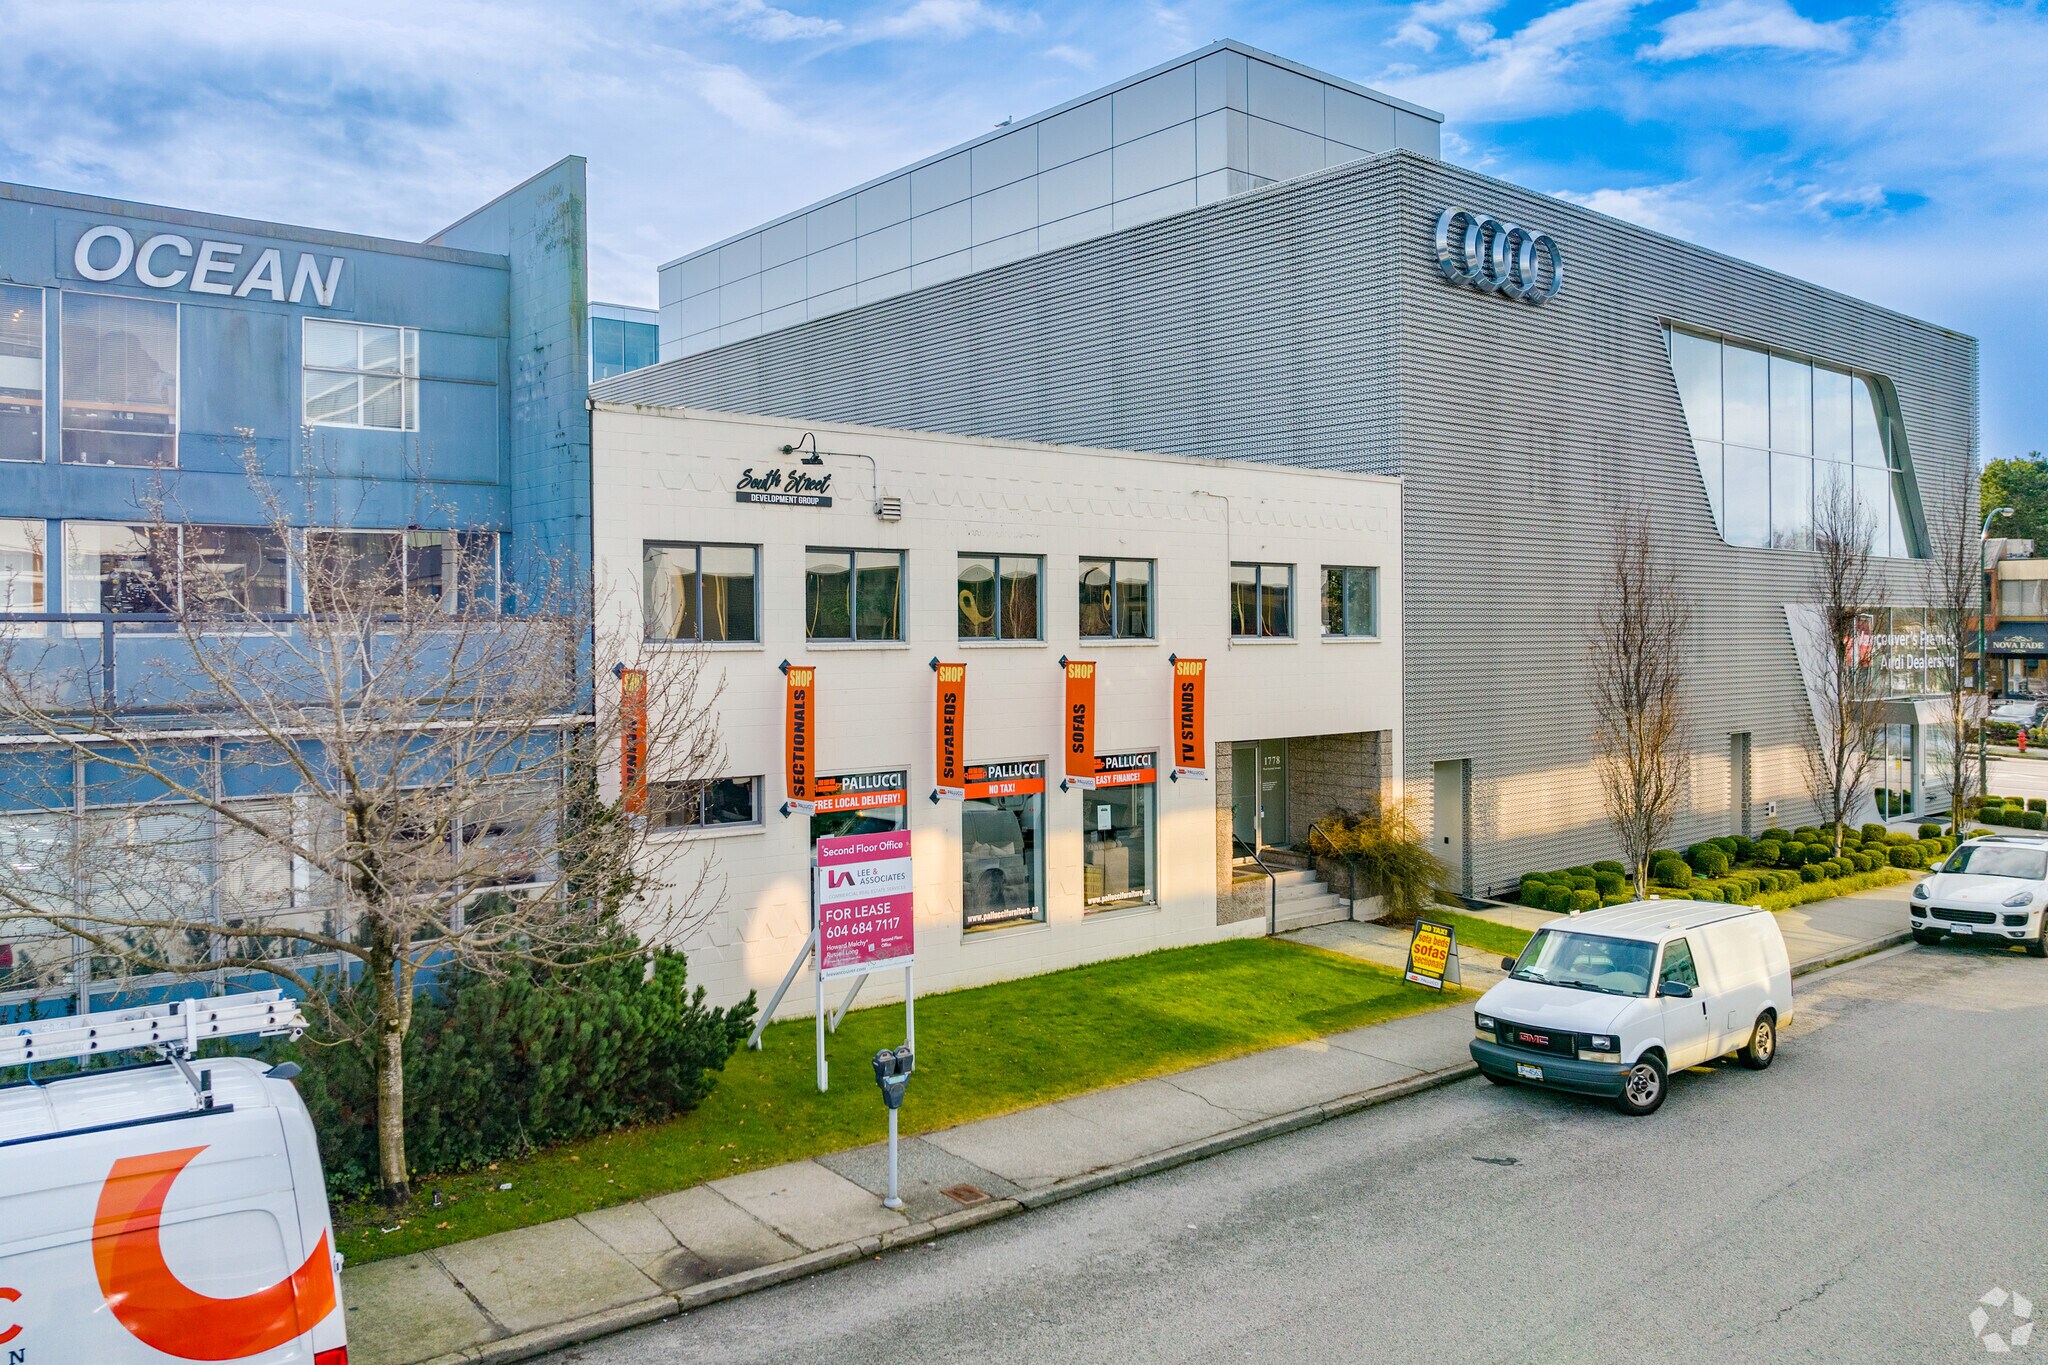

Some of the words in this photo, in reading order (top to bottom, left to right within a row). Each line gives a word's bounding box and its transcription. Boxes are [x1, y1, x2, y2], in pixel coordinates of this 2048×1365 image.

[74, 225, 345, 307] OCEAN
[736, 468, 782, 492] South
[784, 469, 832, 494] Street
[750, 493, 798, 504] DEVELOPMENT
[798, 496, 820, 505] GROUP
[1992, 641, 2018, 649] NOVA
[2020, 641, 2045, 649] FADE
[939, 666, 964, 682] SHOP
[1068, 663, 1094, 679] SHOP
[1176, 661, 1203, 676] SHOP
[789, 669, 813, 687] SHOP
[1181, 682, 1195, 741] STANDS
[943, 692, 957, 779] SOFABEDS
[1072, 703, 1086, 754] SOFAS
[792, 689, 806, 797] SECTIONALS
[1182, 743, 1195, 762] TV
[1264, 755, 1281, 766] 1778
[1105, 754, 1151, 769] PALLUCCI
[988, 763, 1040, 778] PALLUCCI
[1095, 774, 1112, 785] EASY
[1113, 772, 1140, 783] FINANCE!
[841, 773, 901, 791] PALLUCCI
[988, 784, 1000, 794] NO
[1000, 783, 1016, 793] TAX!
[814, 799, 834, 810] FREE
[834, 796, 860, 808] LOCAL
[861, 793, 901, 806] DELIVERY!
[823, 845, 855, 857] Second
[856, 843, 878, 854] Floor
[879, 840, 903, 851] Office
[857, 868, 871, 877] LEE
[859, 872, 906, 885] ASSOCIATES
[1087, 888, 1151, 905] www.palluccifurniture.ca
[825, 908, 851, 922] FOR
[855, 902, 891, 919] LEASE
[967, 905, 1039, 923] www.palluccifurniture.ca
[826, 924, 848, 939] 604
[851, 921, 873, 935] 684
[875, 916, 900, 931] 7117
[1421, 924, 1432, 932] NO
[1432, 926, 1448, 936] TAX!
[1418, 934, 1432, 944] sofa
[1433, 936, 1449, 949] beds
[1413, 943, 1447, 961] sofas
[1413, 955, 1445, 970] sectionals
[1519, 1031, 1549, 1045] GMC
